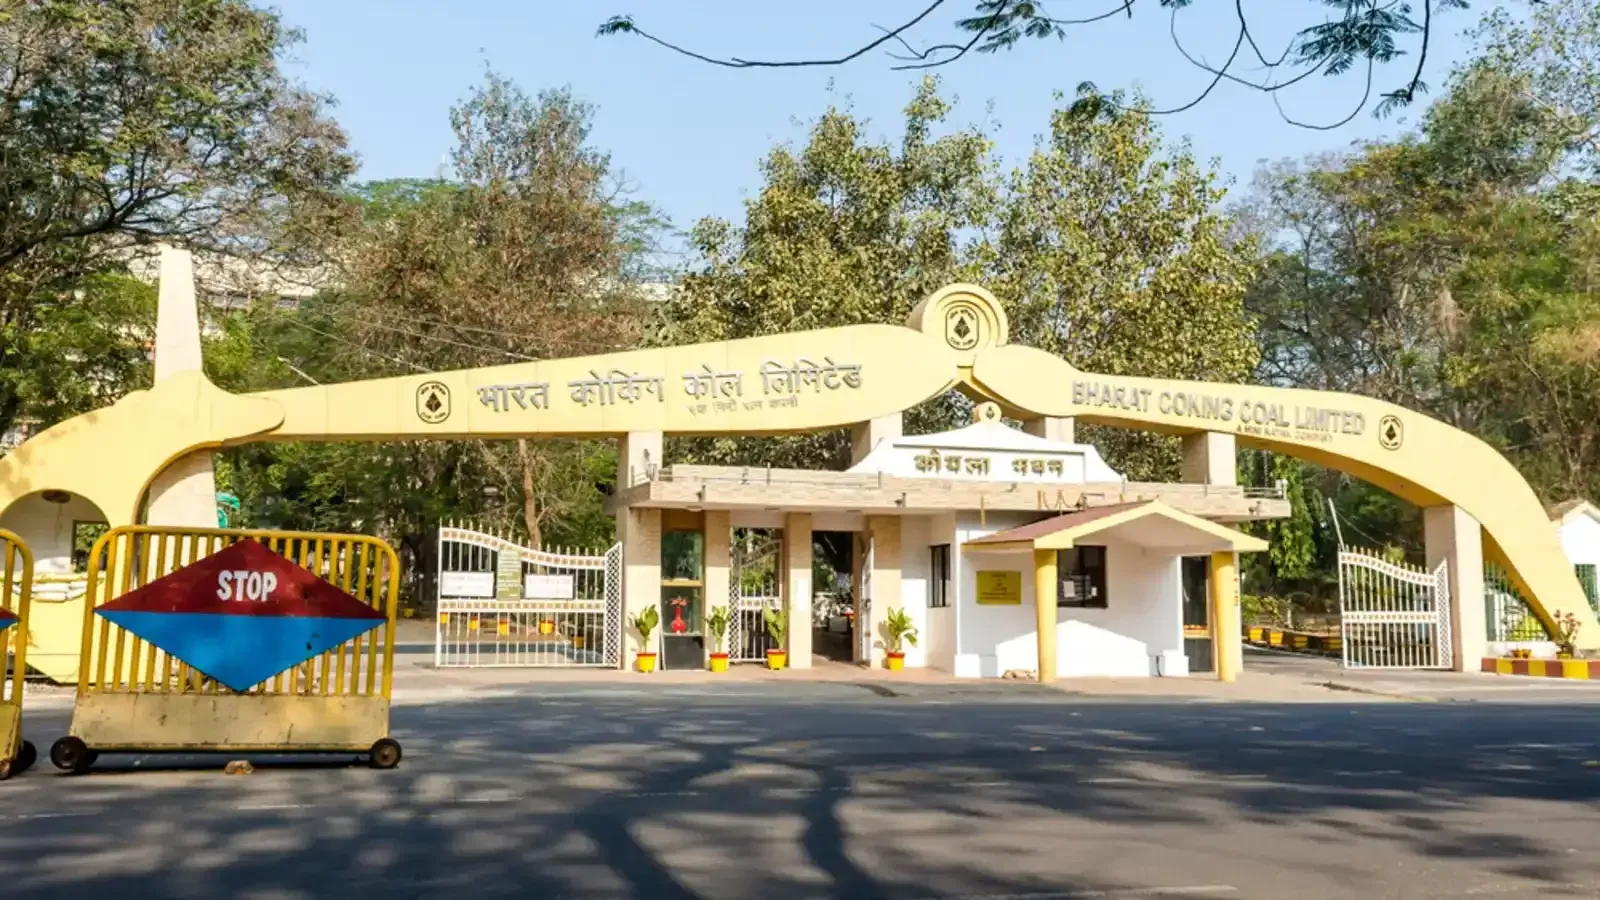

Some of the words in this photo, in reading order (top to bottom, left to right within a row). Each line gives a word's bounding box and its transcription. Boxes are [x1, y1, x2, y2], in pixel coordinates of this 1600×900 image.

[477, 382, 550, 413] भारत
[567, 368, 664, 408] कोकिंग
[681, 363, 743, 400] कोल
[759, 355, 862, 396] लिमिटेड
[1072, 381, 1153, 413] BHARAT
[1239, 399, 1290, 428] COAL
[1295, 405, 1366, 436] LIMITED
[913, 447, 991, 476] कोयला
[216, 569, 278, 602] STOP
